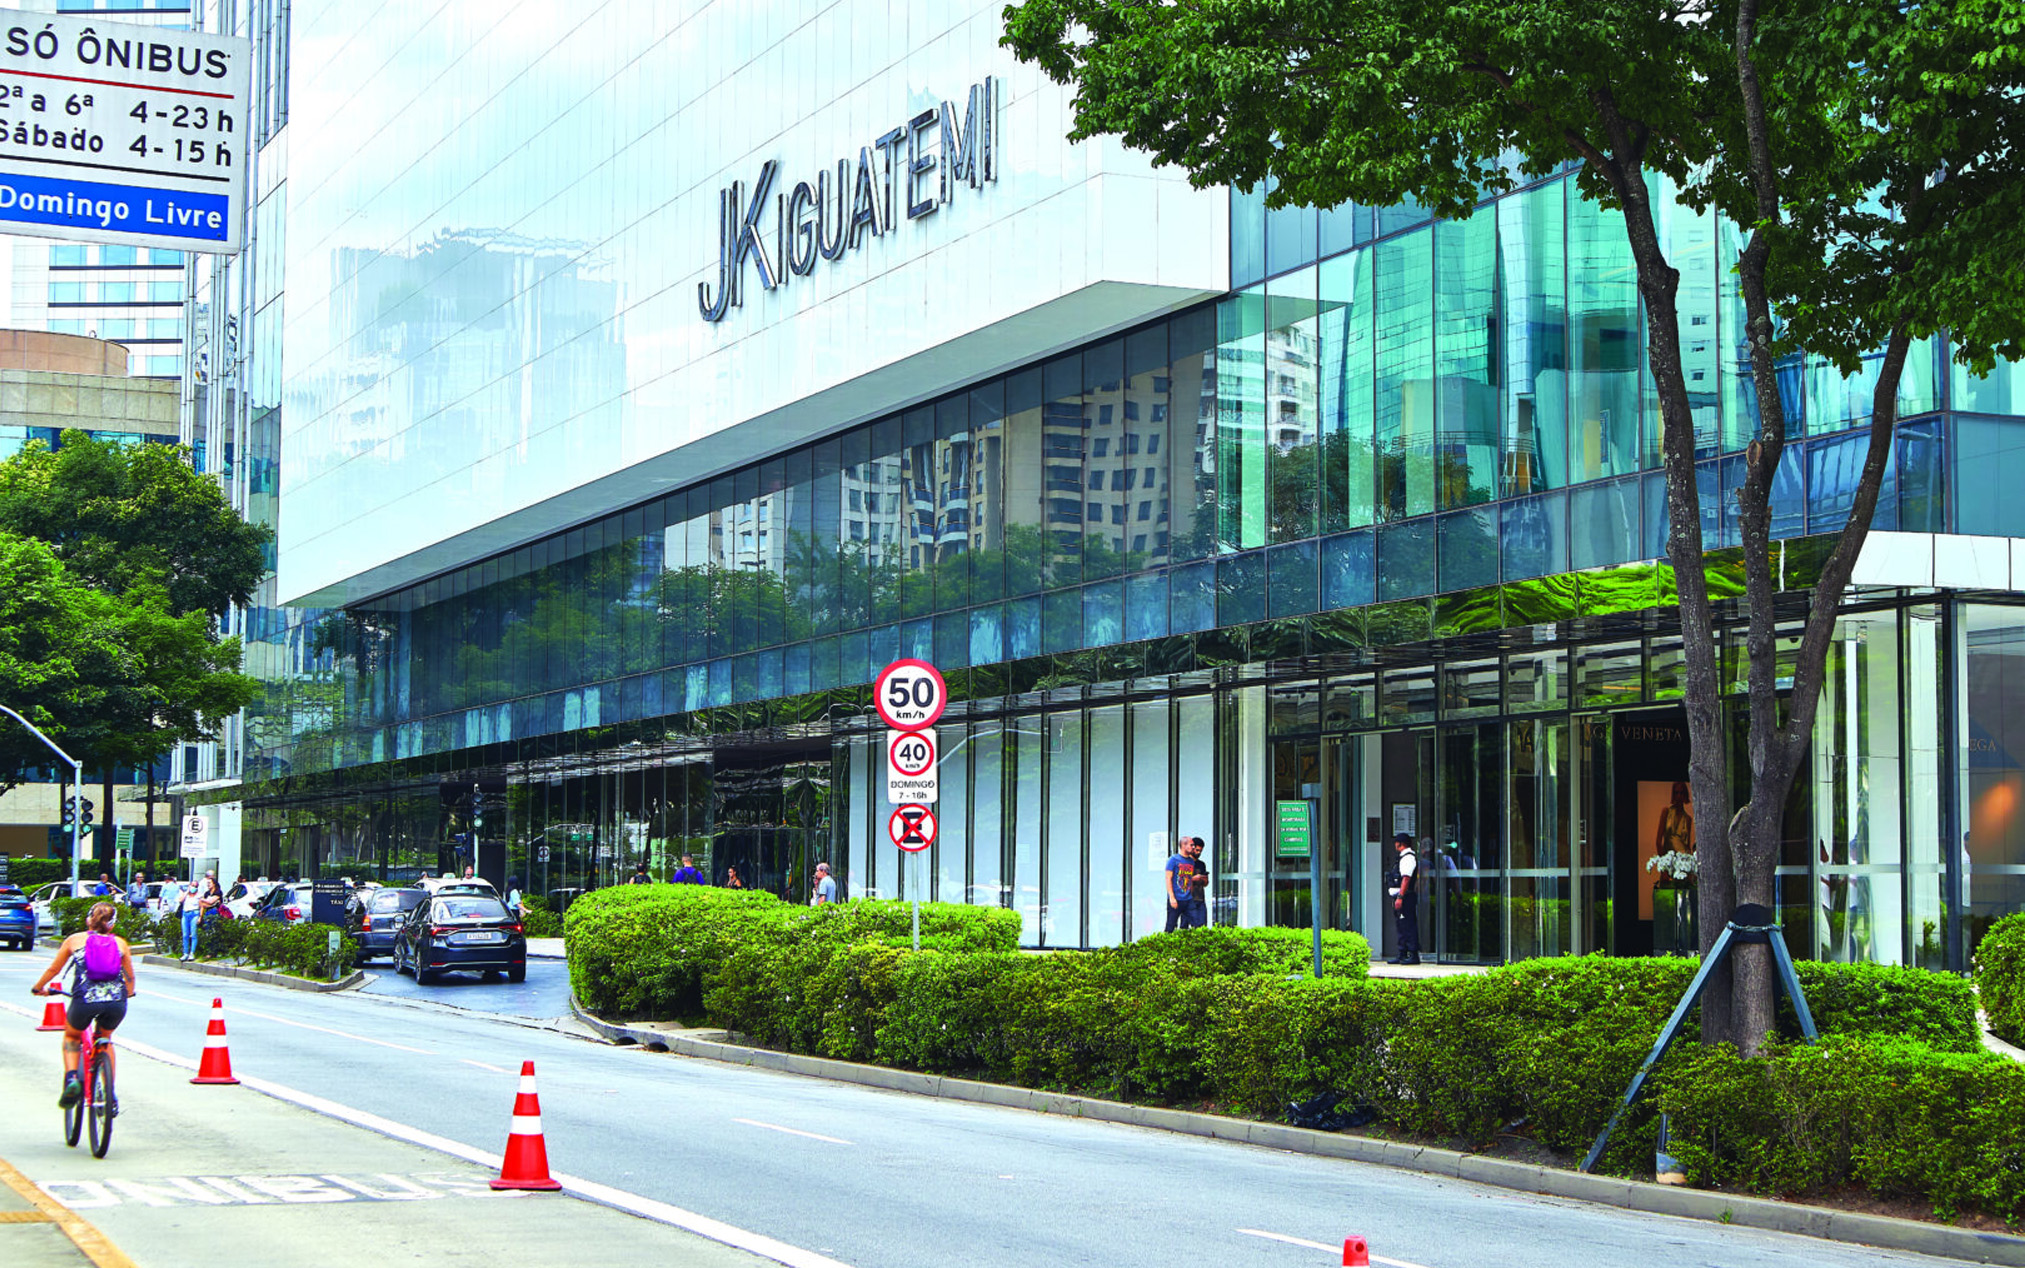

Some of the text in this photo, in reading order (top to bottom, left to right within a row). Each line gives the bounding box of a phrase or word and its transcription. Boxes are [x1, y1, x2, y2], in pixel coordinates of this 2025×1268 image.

[6, 24, 228, 79] SÓ ÔNIBUS
[31, 93, 46, 113] a
[0, 118, 104, 153] Sábado
[0, 184, 222, 230] Domingo Livre
[697, 74, 999, 322] JK IGUATEMI
[888, 677, 935, 708] 50
[896, 710, 925, 720] km/h
[1621, 726, 1682, 742] VENETA
[899, 743, 926, 762] 40
[890, 780, 936, 789] DOMINGO
[191, 820, 200, 831] E
